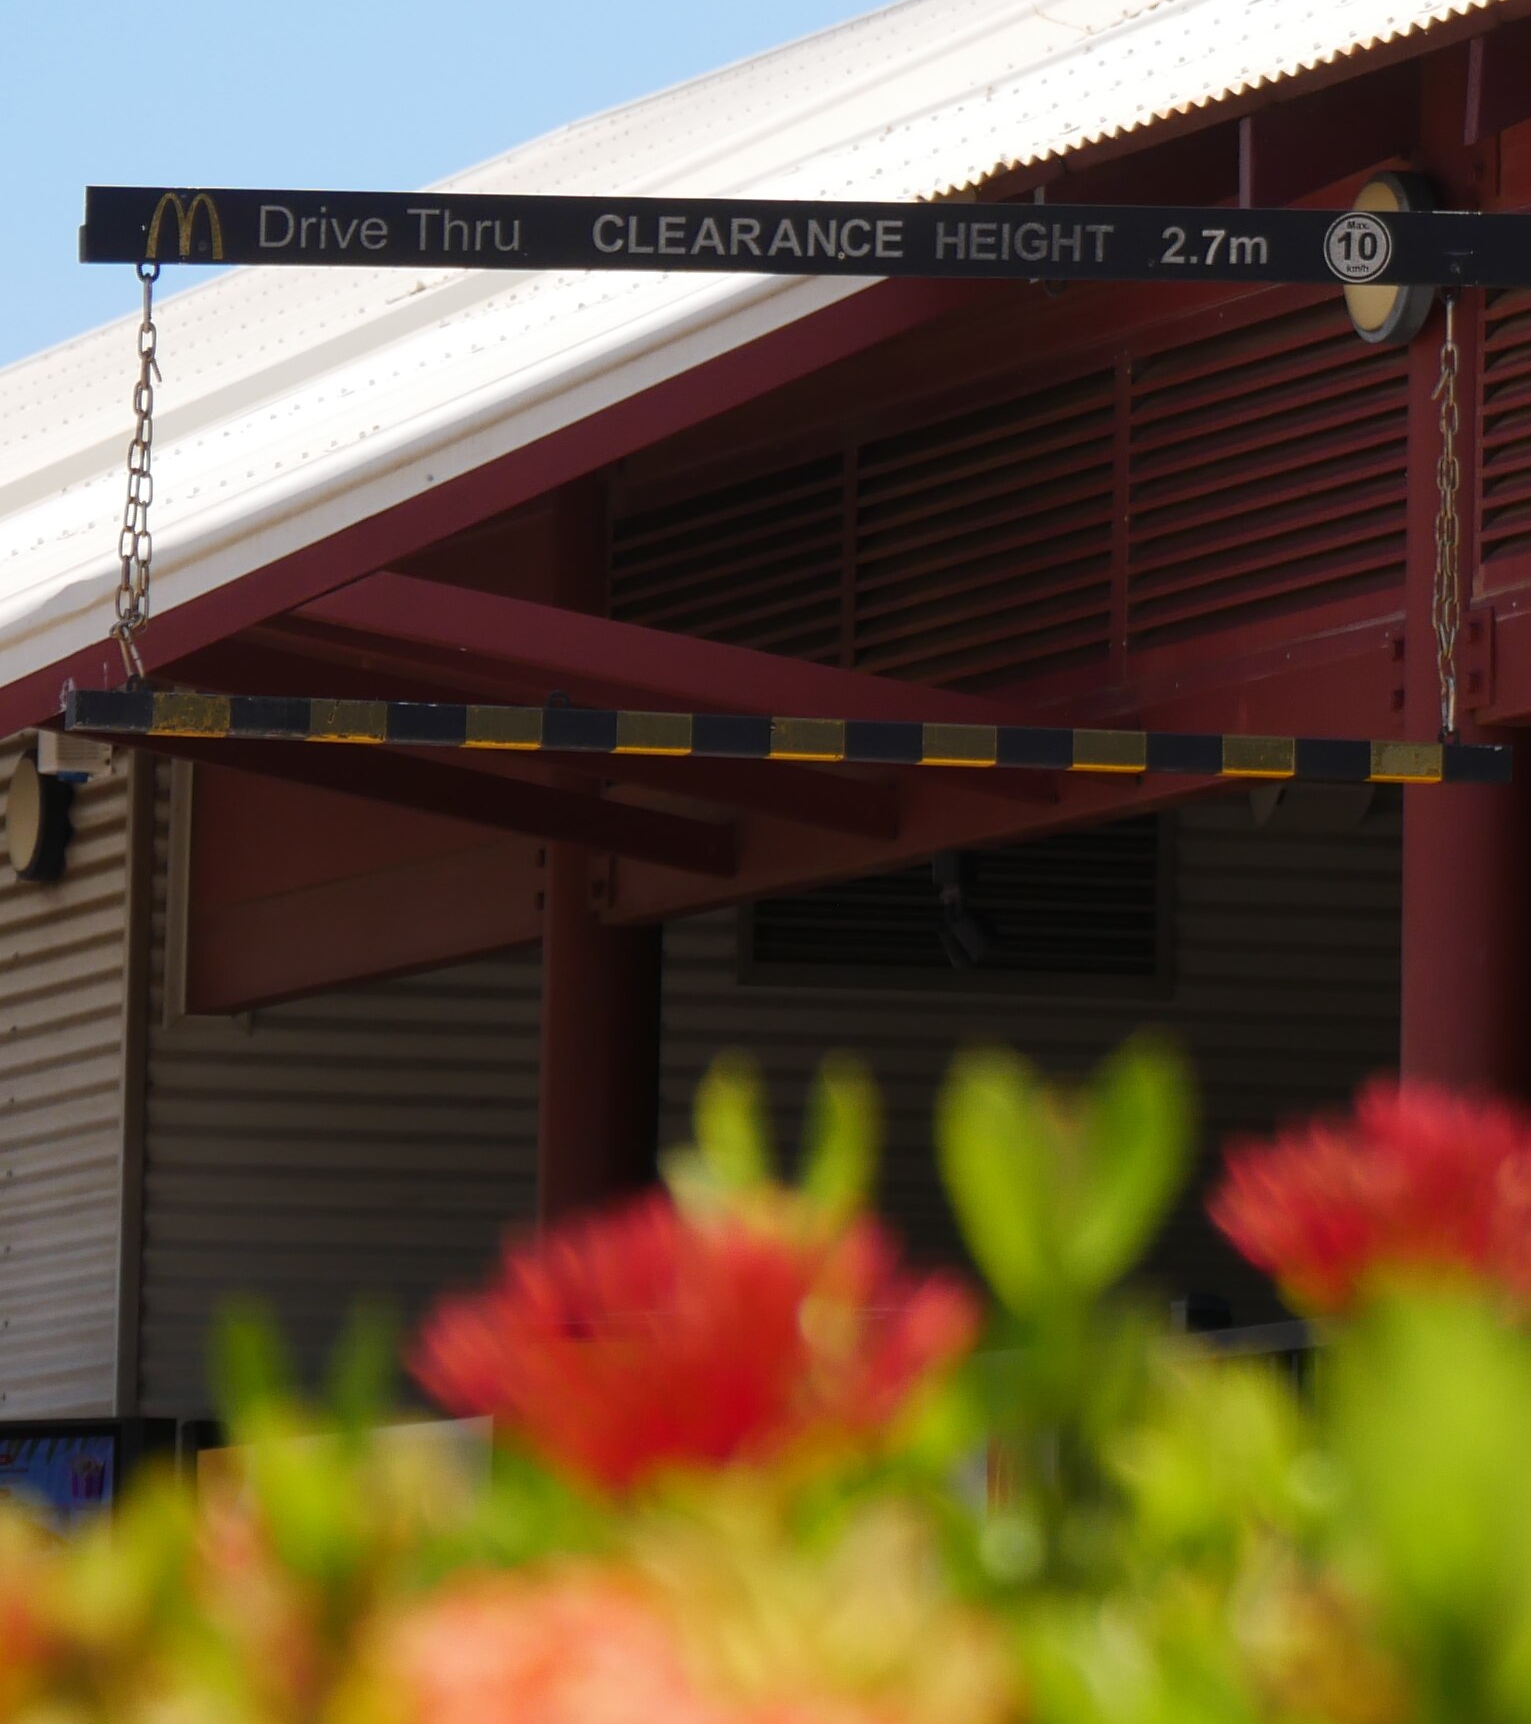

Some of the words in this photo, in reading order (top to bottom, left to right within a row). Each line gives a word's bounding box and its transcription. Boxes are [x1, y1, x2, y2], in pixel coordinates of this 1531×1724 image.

[259, 204, 389, 250] Drive
[407, 208, 520, 252] Thru
[592, 213, 904, 259] CLEARANCE
[934, 221, 1115, 263] HEIGHT
[1160, 226, 1269, 266] 2.7m
[1337, 231, 1378, 261] 10
